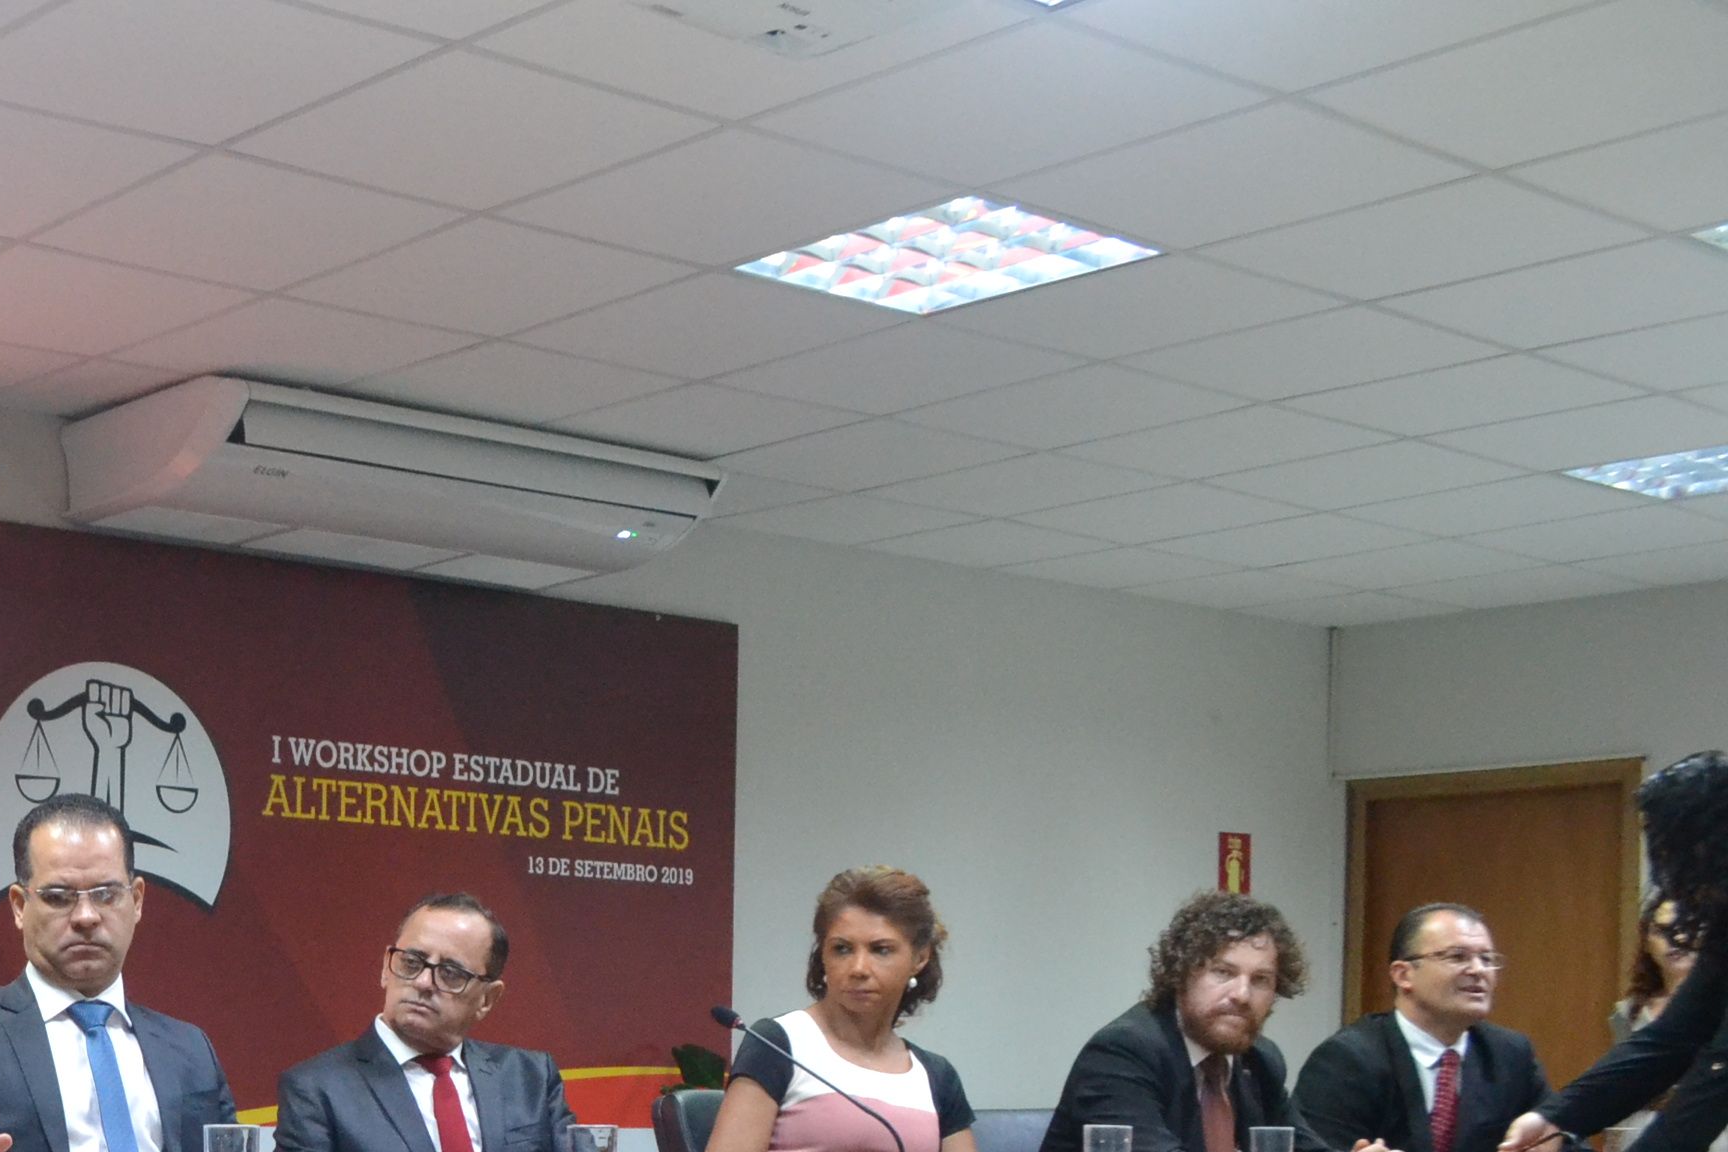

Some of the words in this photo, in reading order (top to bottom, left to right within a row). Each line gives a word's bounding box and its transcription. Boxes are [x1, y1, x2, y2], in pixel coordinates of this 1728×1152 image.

[272, 735, 282, 763] I
[288, 737, 446, 778] WORKSHOP
[453, 754, 581, 792] ESTADUAL
[587, 767, 620, 795] DE
[262, 774, 550, 838] ALTERNATIVAS
[562, 801, 689, 850] PENAIS
[527, 856, 545, 874] 13
[548, 858, 570, 877] DE
[574, 860, 658, 883] SETEMBRO
[661, 867, 694, 885] 2019
